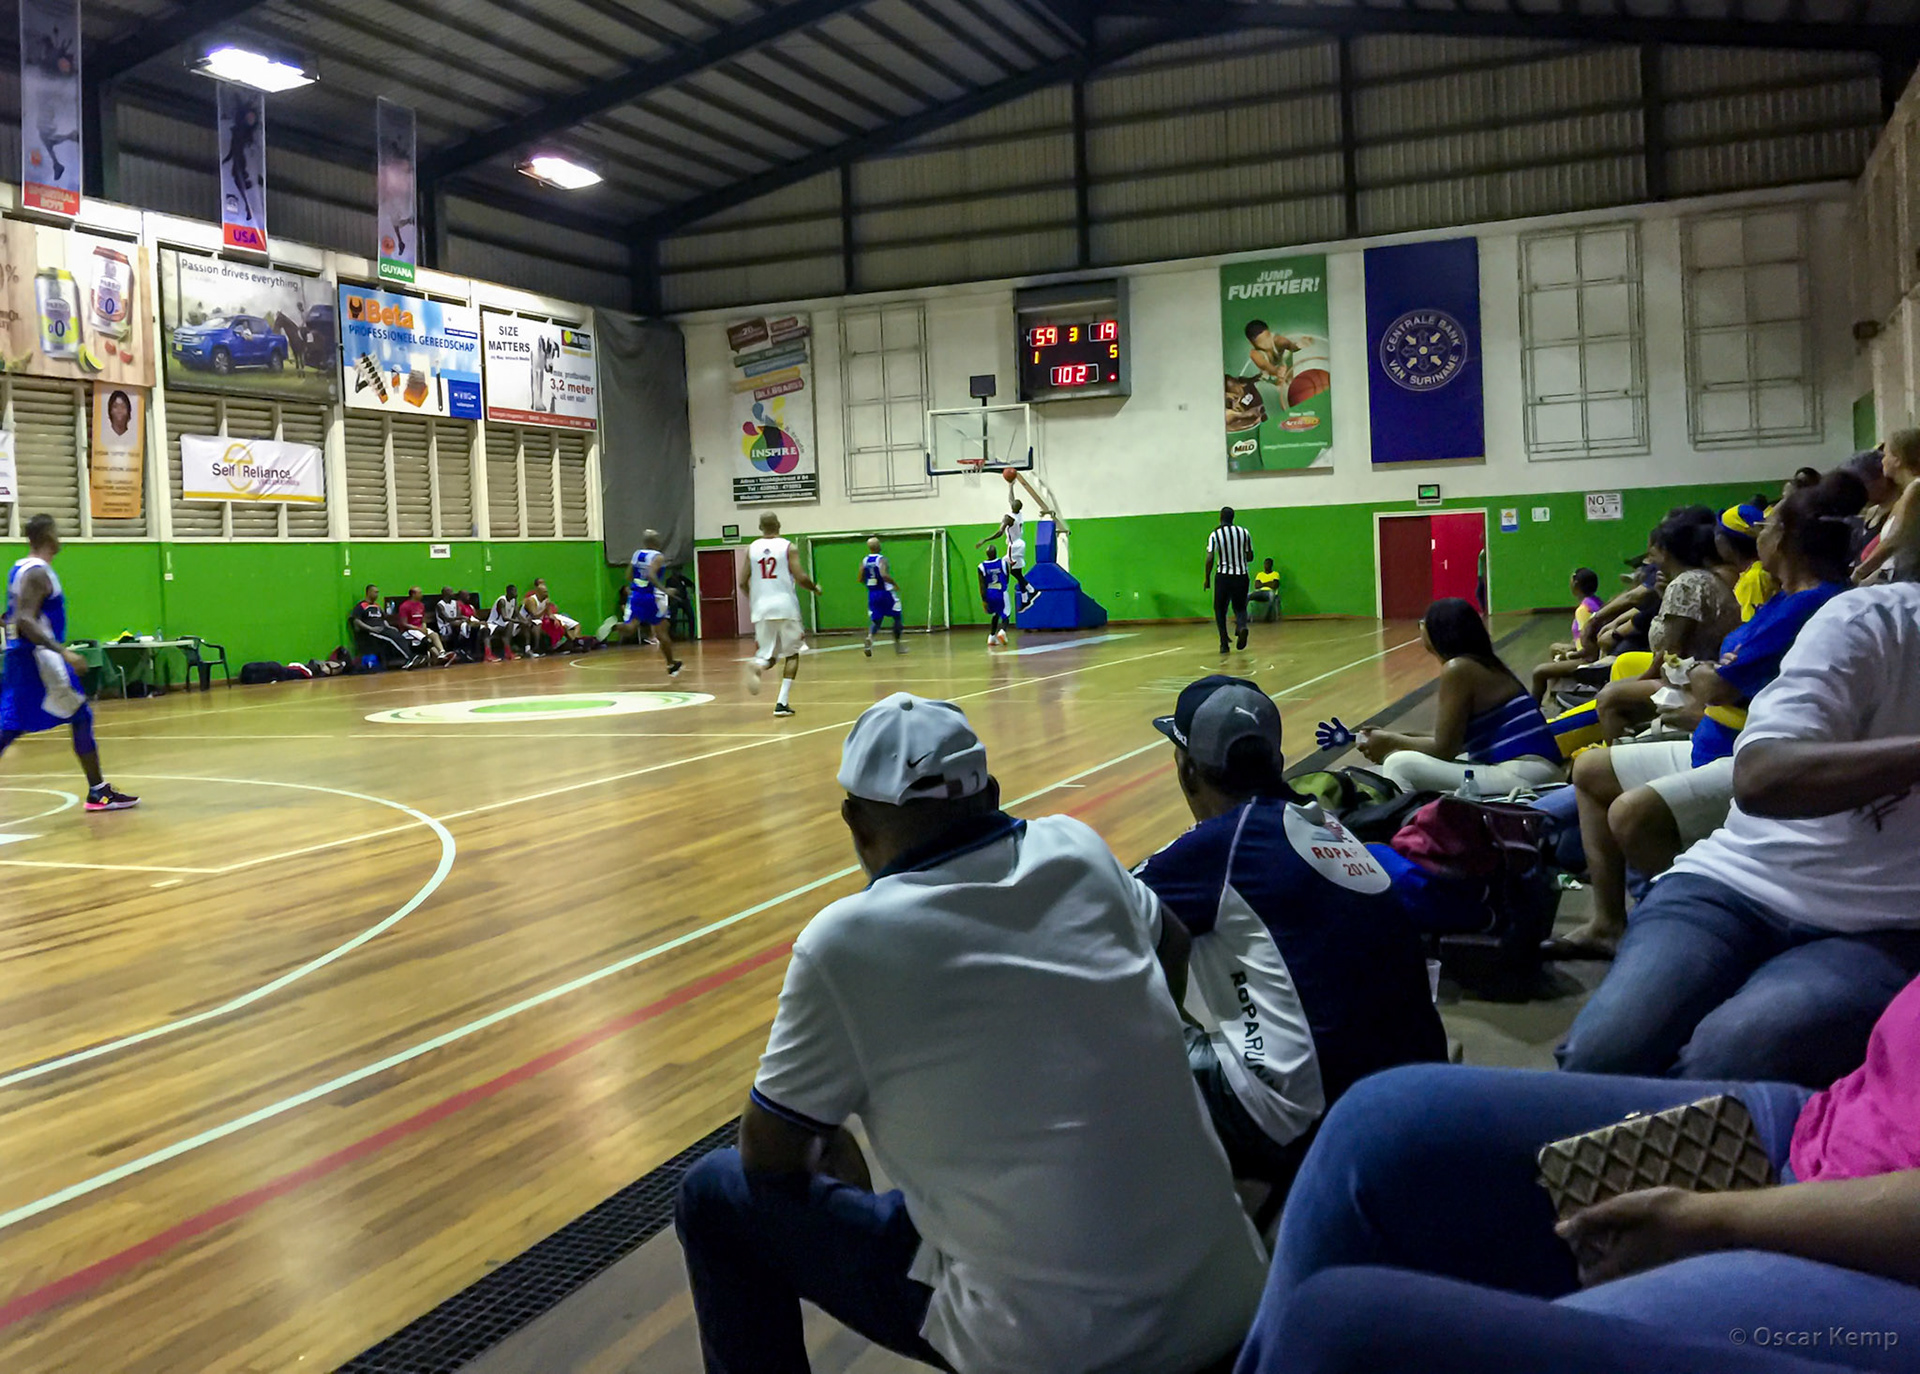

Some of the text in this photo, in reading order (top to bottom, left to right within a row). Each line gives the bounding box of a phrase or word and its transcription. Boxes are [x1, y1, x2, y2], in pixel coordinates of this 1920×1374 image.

[233, 229, 258, 244] USA
[181, 259, 299, 292] Passion drives everything
[381, 263, 413, 278] GUYANA
[1257, 269, 1293, 282] JUMP
[1228, 277, 1320, 300] FURTHER!
[365, 298, 414, 329] Beta
[349, 324, 475, 352] PROFESSIONEEL GEREEDSCHAP
[498, 325, 519, 336] SIZE
[1036, 323, 1115, 345] 59 3 19
[1386, 316, 1460, 352] CENTRALE BANK
[488, 340, 531, 353] MATTERS
[1109, 344, 1118, 358] 5
[1389, 354, 1459, 385] VAN SURINAME
[550, 378, 595, 395] 3,2 meter
[752, 447, 797, 458] INSPIRE
[212, 462, 291, 479] Self Reliance
[1588, 495, 1605, 505] NO
[758, 557, 777, 579] 12
[1342, 862, 1377, 877] 2014
